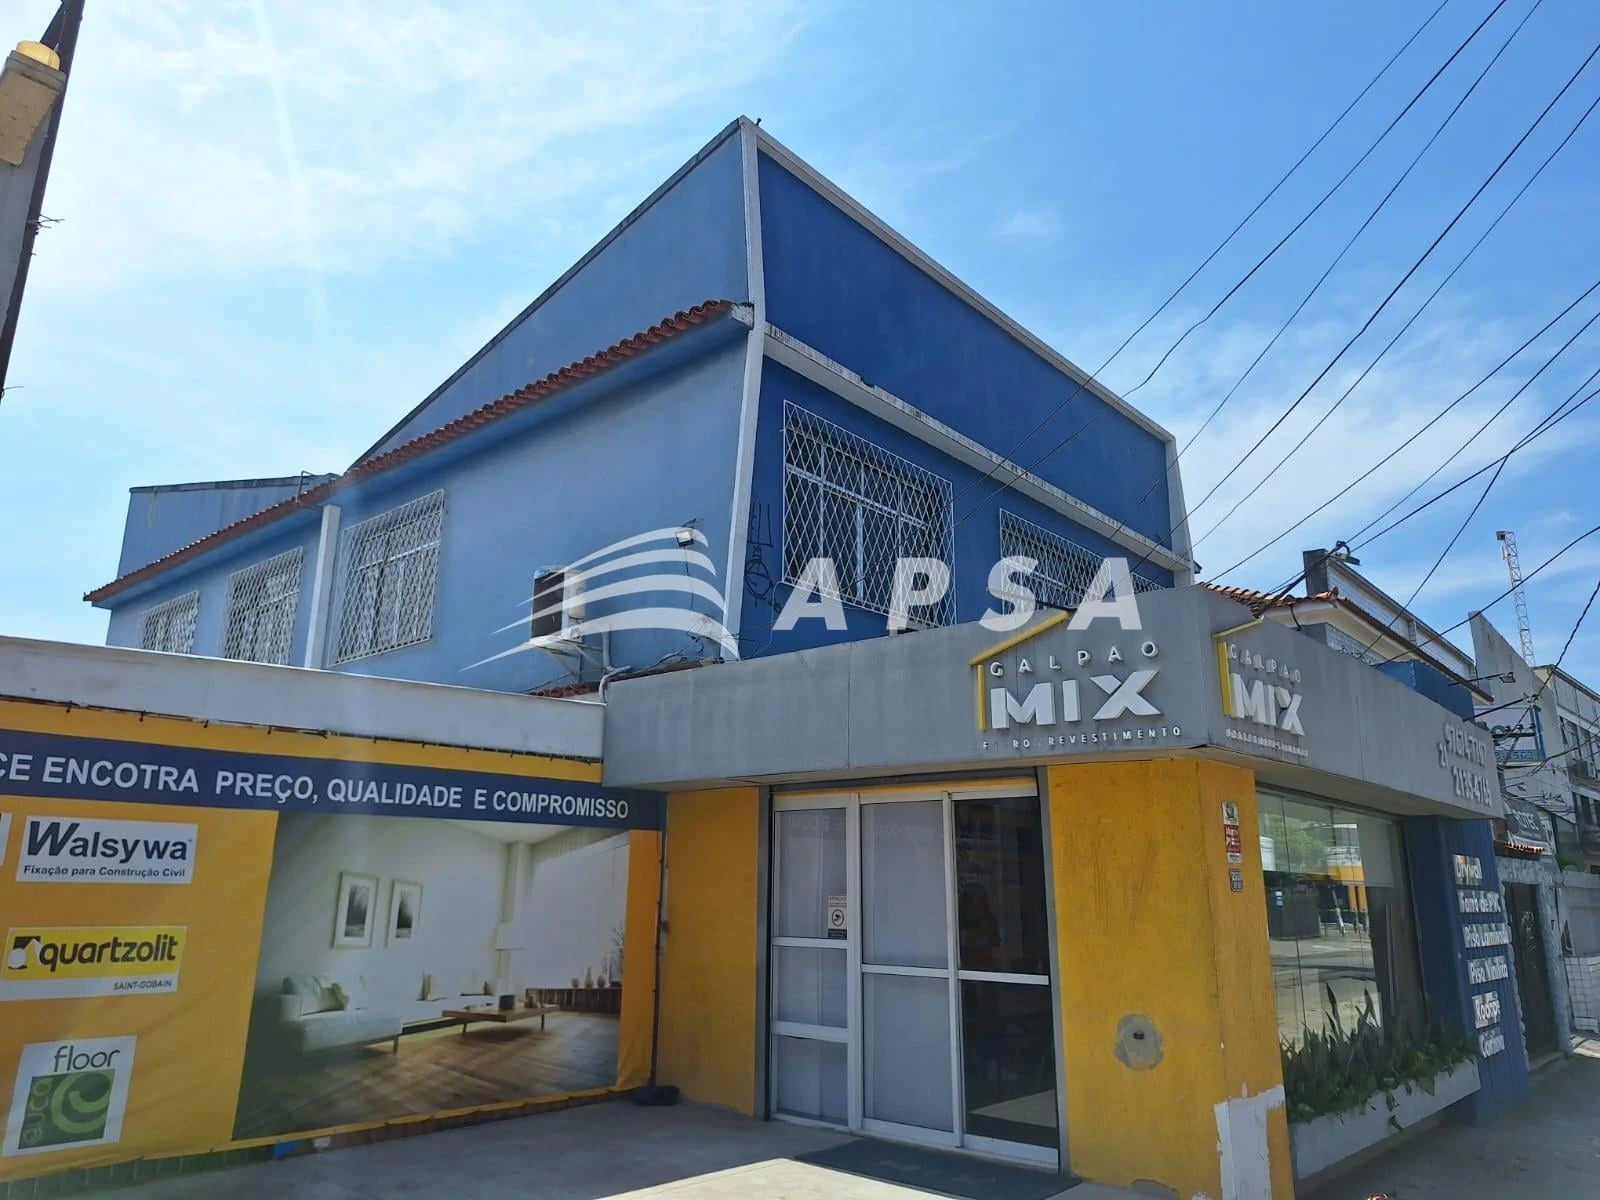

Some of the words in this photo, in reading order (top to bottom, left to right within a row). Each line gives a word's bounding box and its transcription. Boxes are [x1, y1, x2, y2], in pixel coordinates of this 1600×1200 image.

[990, 669, 1162, 729] MIX
[1230, 672, 1305, 736] MIX
[1047, 726, 1181, 746] REVESTIMENTO
[42, 756, 200, 793] ENCOTRA
[215, 770, 319, 805] PREÇO,
[326, 778, 463, 808] QUALIDADE
[473, 788, 487, 810] E
[493, 790, 629, 820] COMPROMISSO
[27, 820, 187, 864] Walsywa
[23, 864, 68, 876] Fixação
[71, 867, 96, 877] para
[99, 866, 160, 879] Construção
[162, 868, 185, 878] Civil
[39, 934, 179, 973] quartzolit
[112, 979, 173, 991] SAINT-GOBAIN
[54, 1045, 121, 1073] floor
